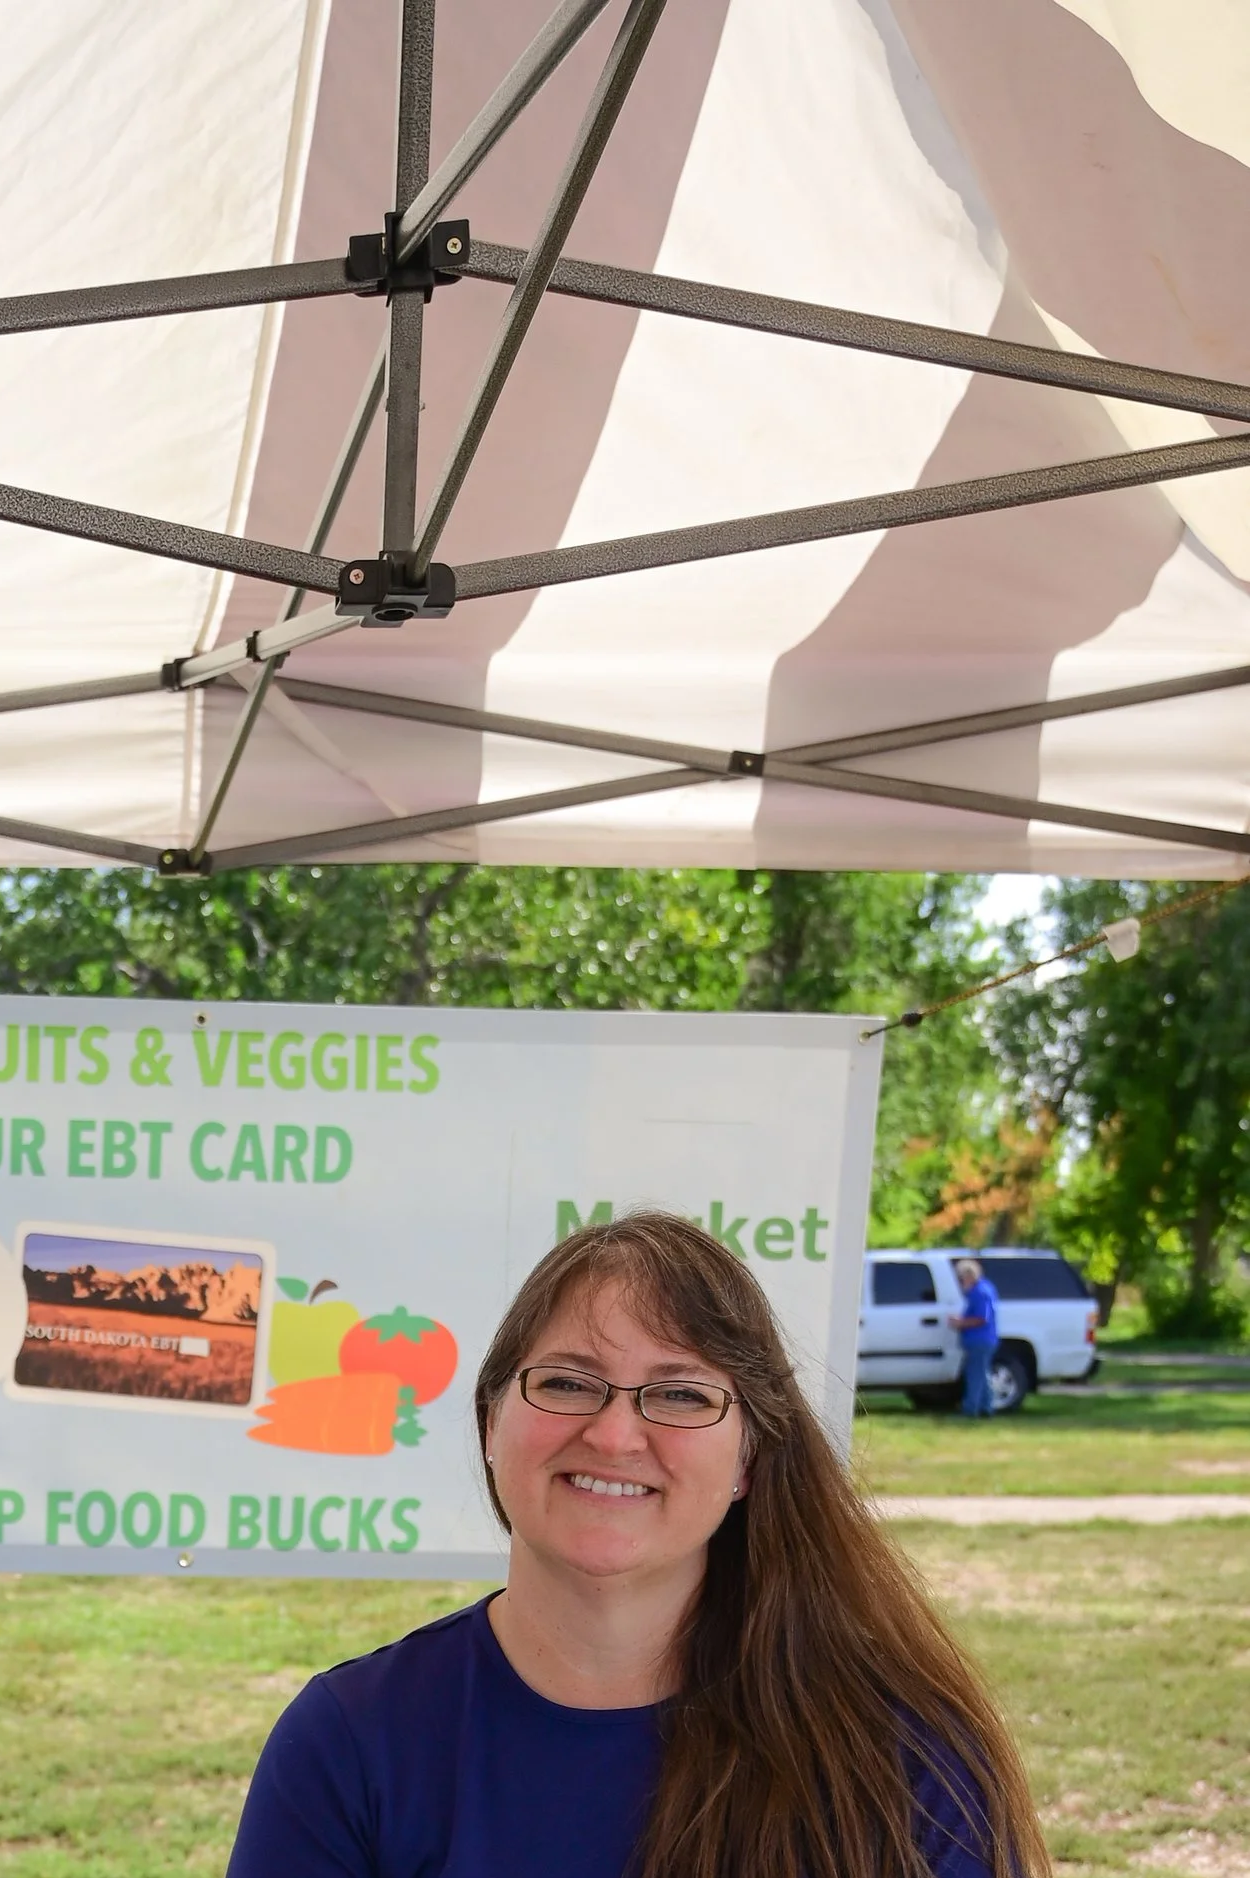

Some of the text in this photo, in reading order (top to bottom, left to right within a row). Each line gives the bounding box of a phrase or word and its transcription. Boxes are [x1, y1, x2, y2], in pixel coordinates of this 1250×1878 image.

[129, 1027, 174, 1087] &
[192, 1030, 441, 1095] VEGGIES
[67, 1120, 172, 1180] EBT
[189, 1122, 354, 1184] CARD
[556, 1200, 830, 1262] Mket
[26, 1325, 181, 1351] SOUTH DAKOTA EBT
[46, 1489, 206, 1549] FOOD
[228, 1495, 421, 1554] BUCKS
